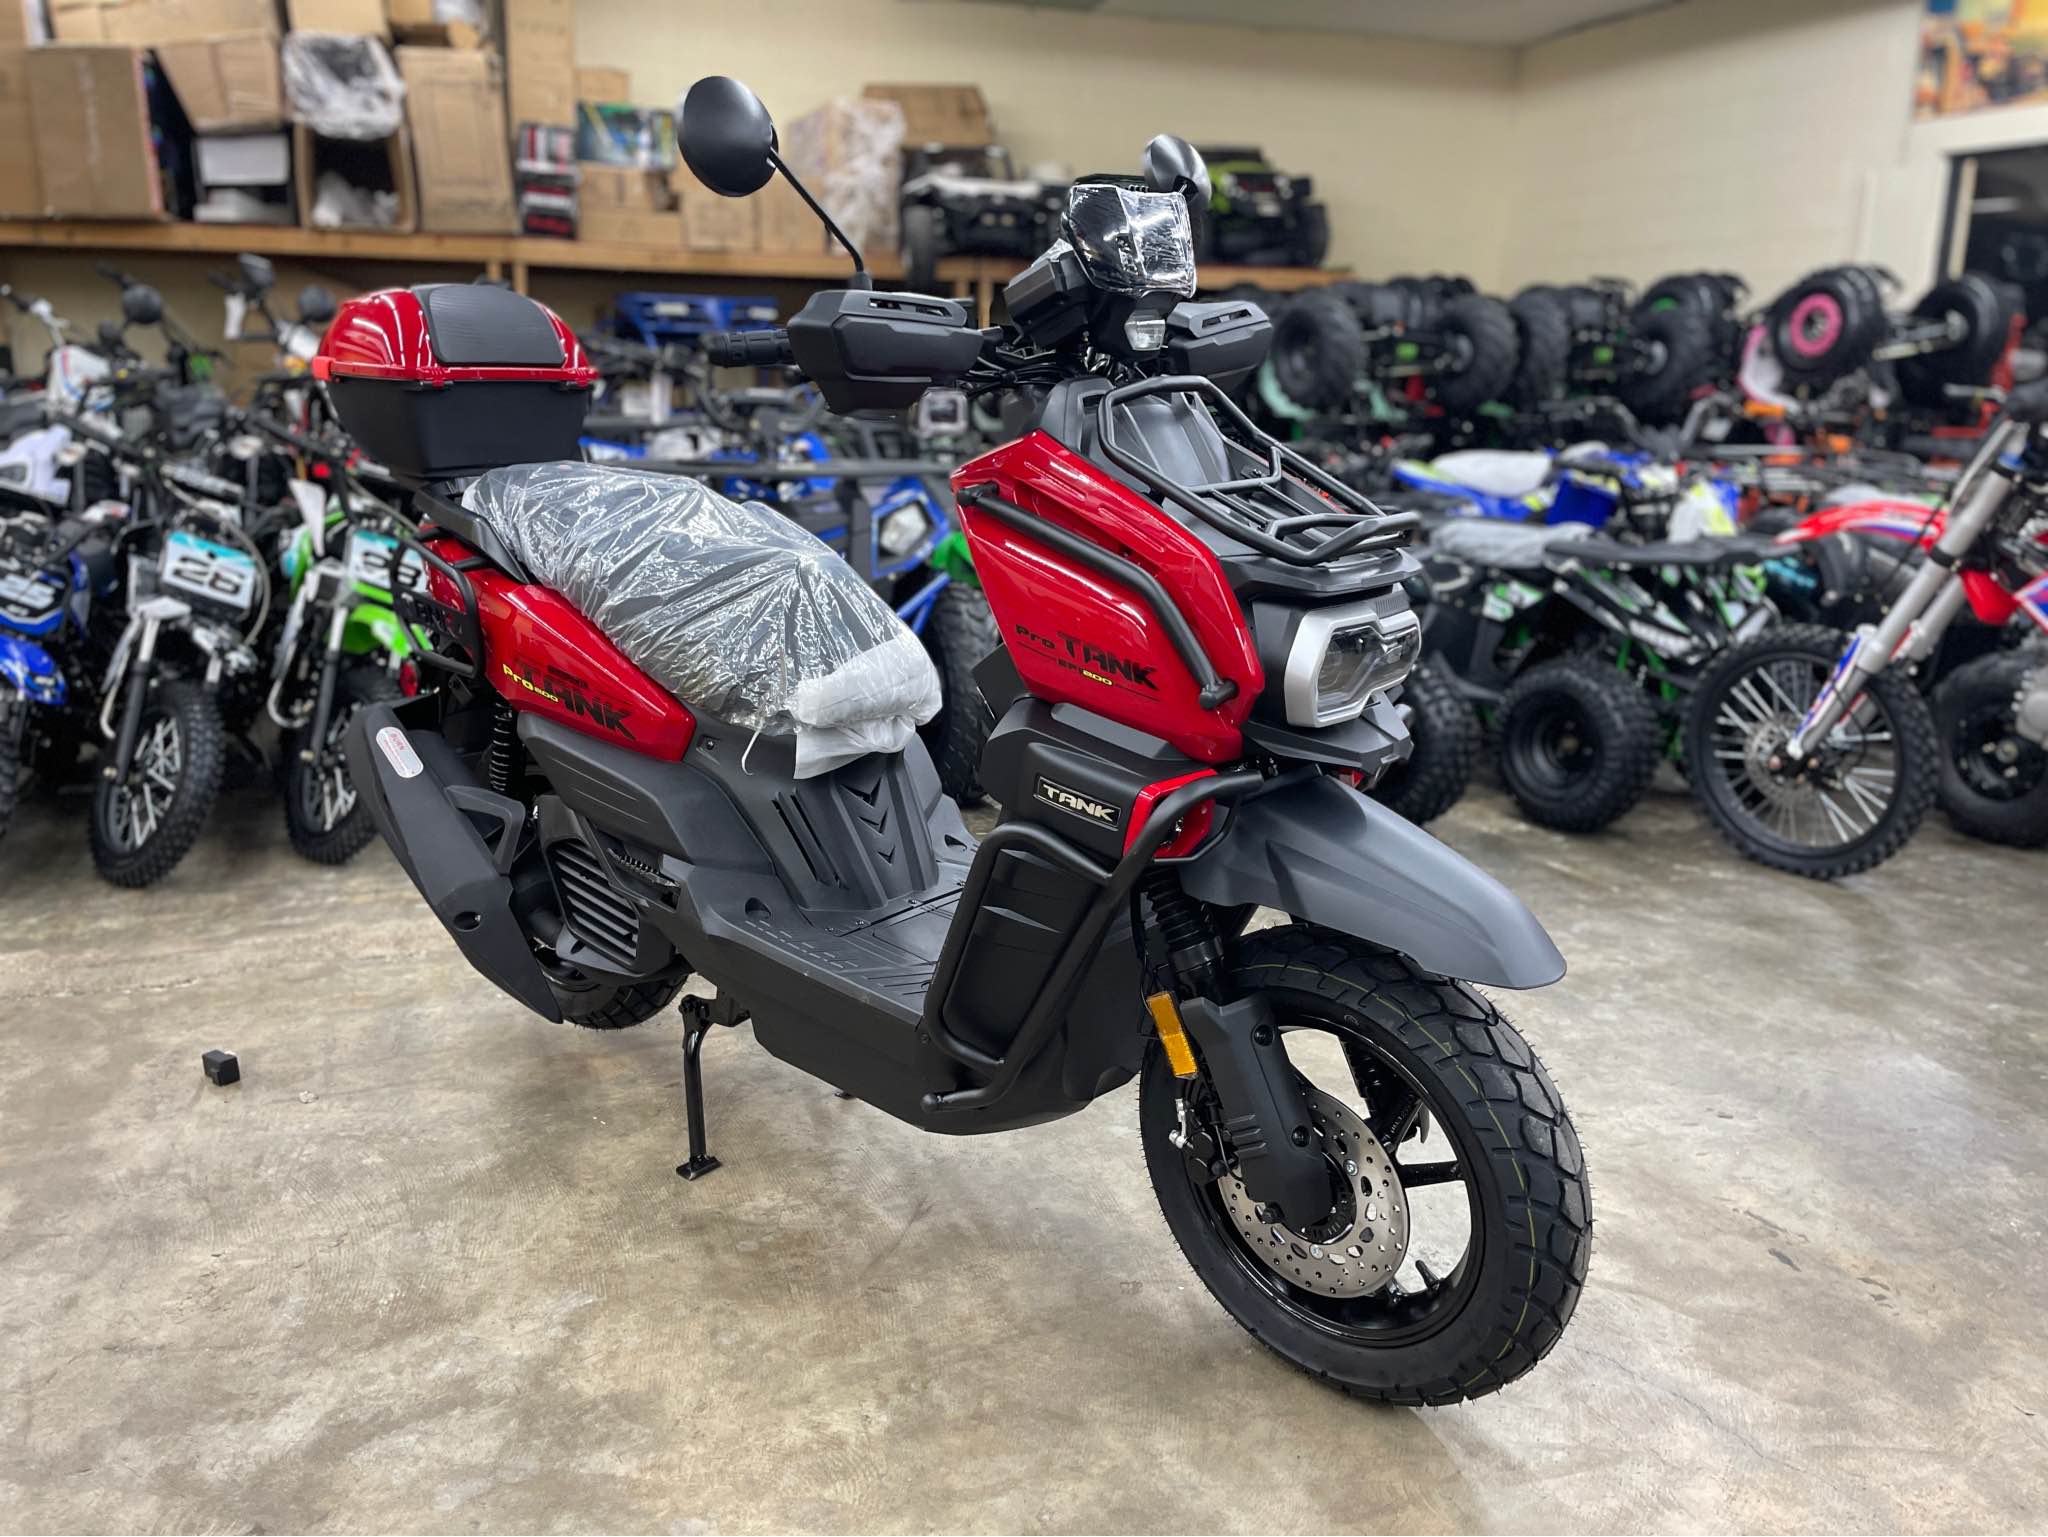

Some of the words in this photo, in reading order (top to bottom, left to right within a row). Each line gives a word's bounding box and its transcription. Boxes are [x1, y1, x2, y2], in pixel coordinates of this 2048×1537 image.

[1015, 624, 1056, 649] Pro
[1056, 631, 1160, 691] TANK
[1042, 783, 1115, 822] TANK
